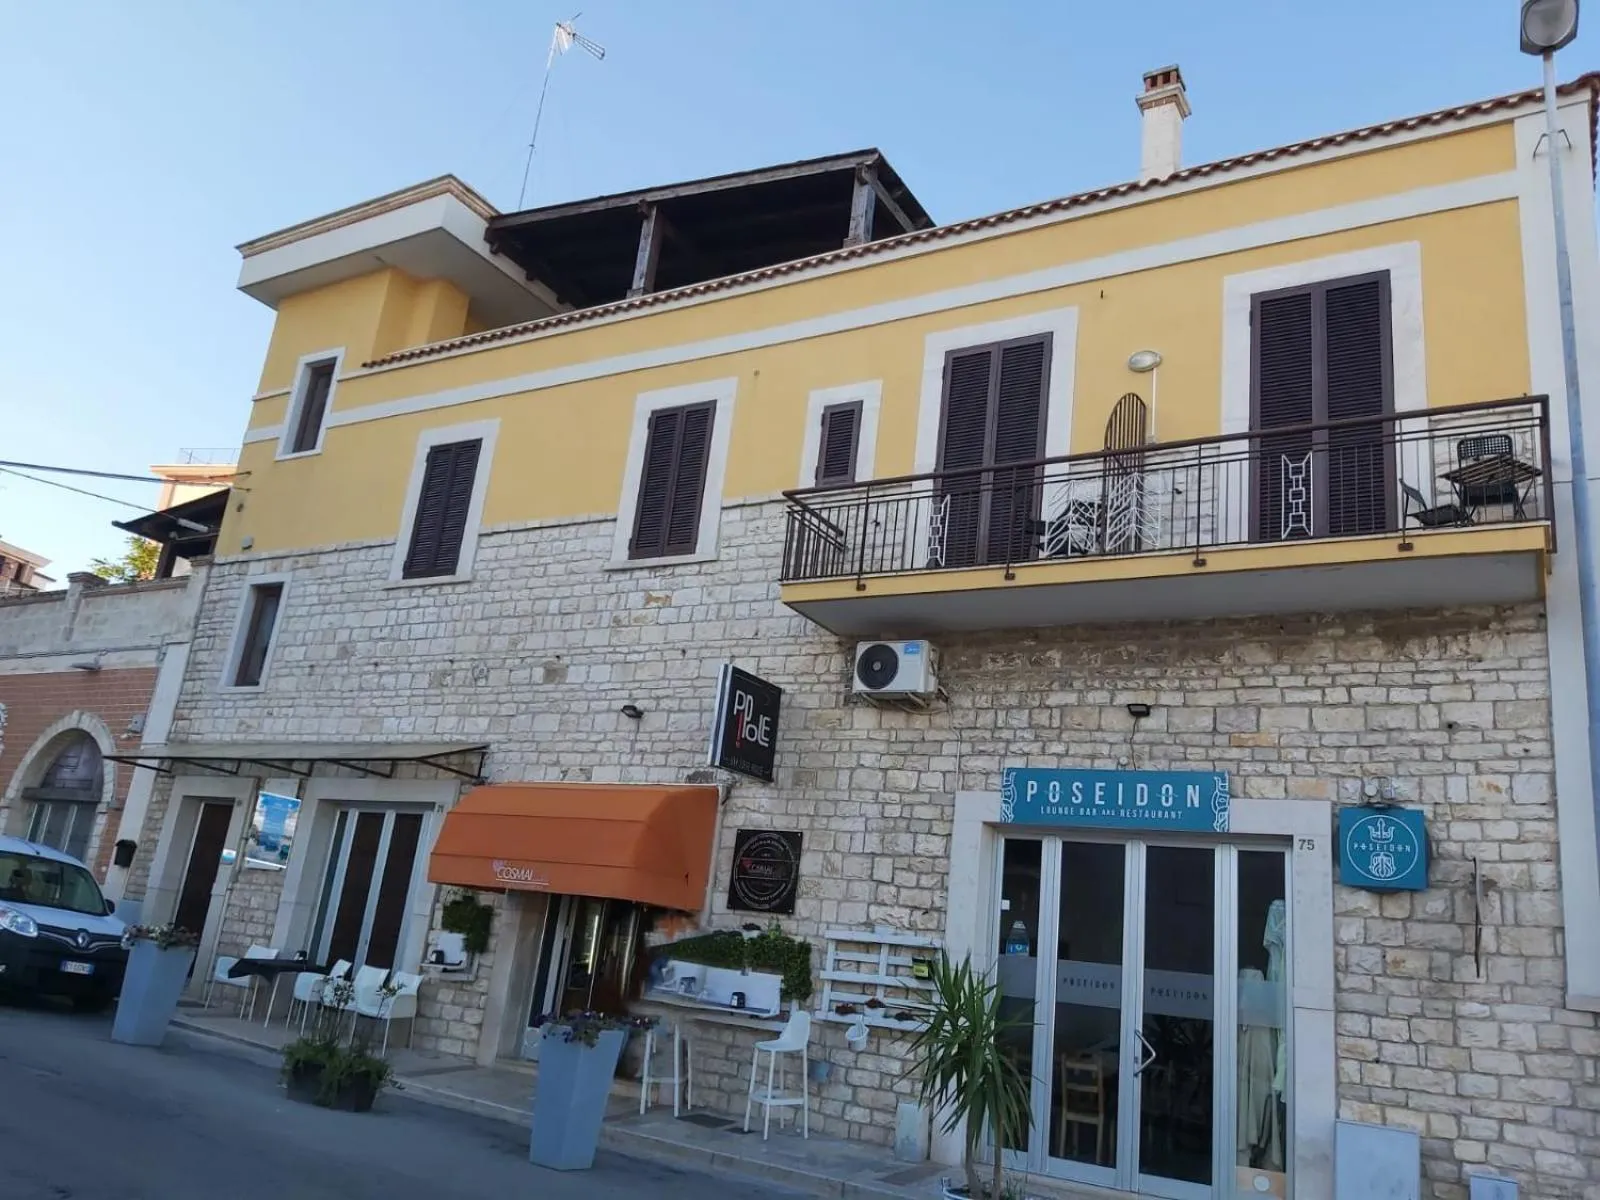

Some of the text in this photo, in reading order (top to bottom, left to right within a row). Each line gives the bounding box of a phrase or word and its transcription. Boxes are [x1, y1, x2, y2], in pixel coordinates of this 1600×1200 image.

[1026, 780, 1200, 808] POSEIDON
[1040, 806, 1075, 816] LOUNGE
[1080, 807, 1097, 816] BAR
[1120, 809, 1183, 819] RESTAURANT
[1298, 838, 1315, 851] 75
[1353, 842, 1411, 853] POSEIDON
